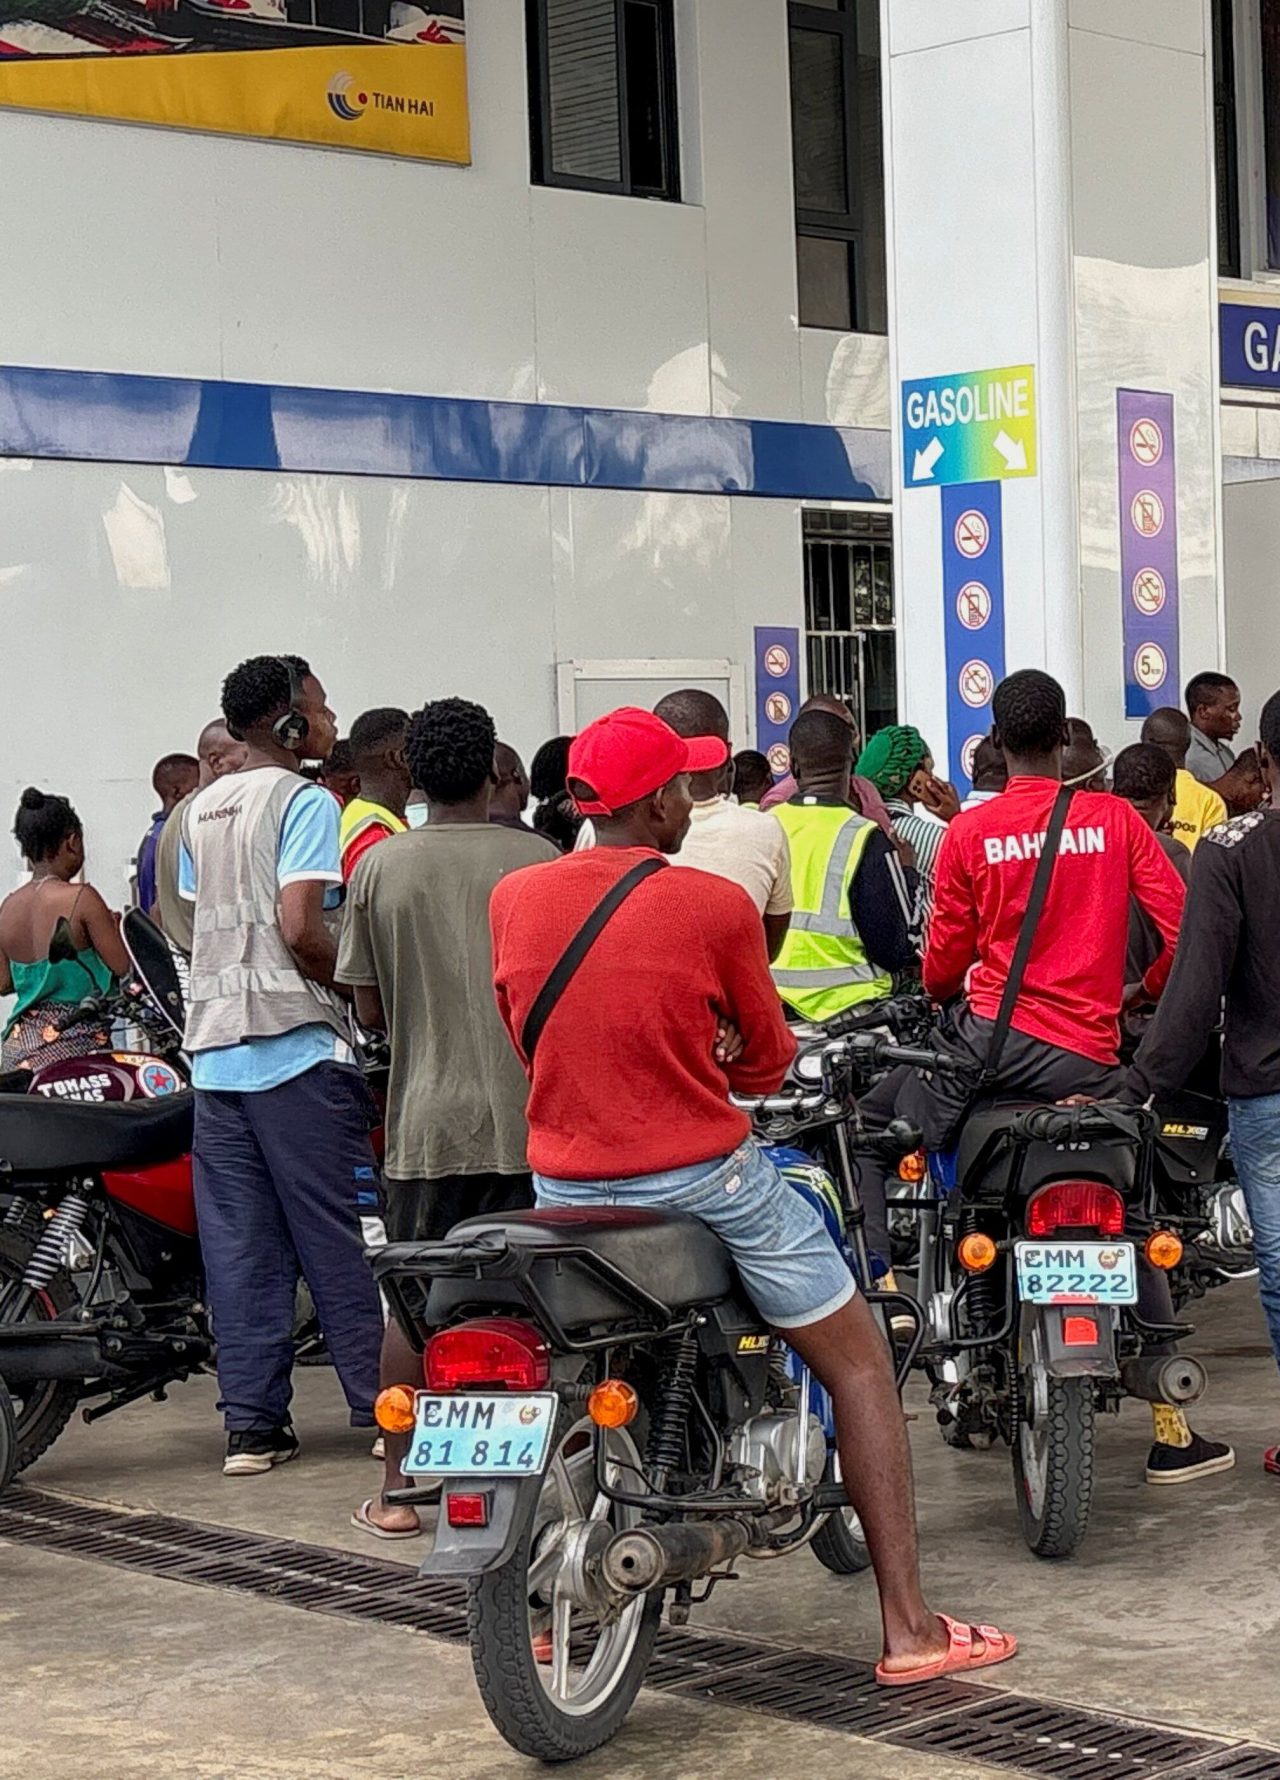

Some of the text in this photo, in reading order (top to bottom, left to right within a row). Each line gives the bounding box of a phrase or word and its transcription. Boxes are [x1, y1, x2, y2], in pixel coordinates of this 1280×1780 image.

[371, 91, 434, 117] TIAN HAI
[906, 378, 1030, 430] GASOLINE
[37, 1073, 112, 1098] TOMASS
[1027, 1274, 1129, 1294] 82222
[414, 1440, 534, 1468] 81 814
